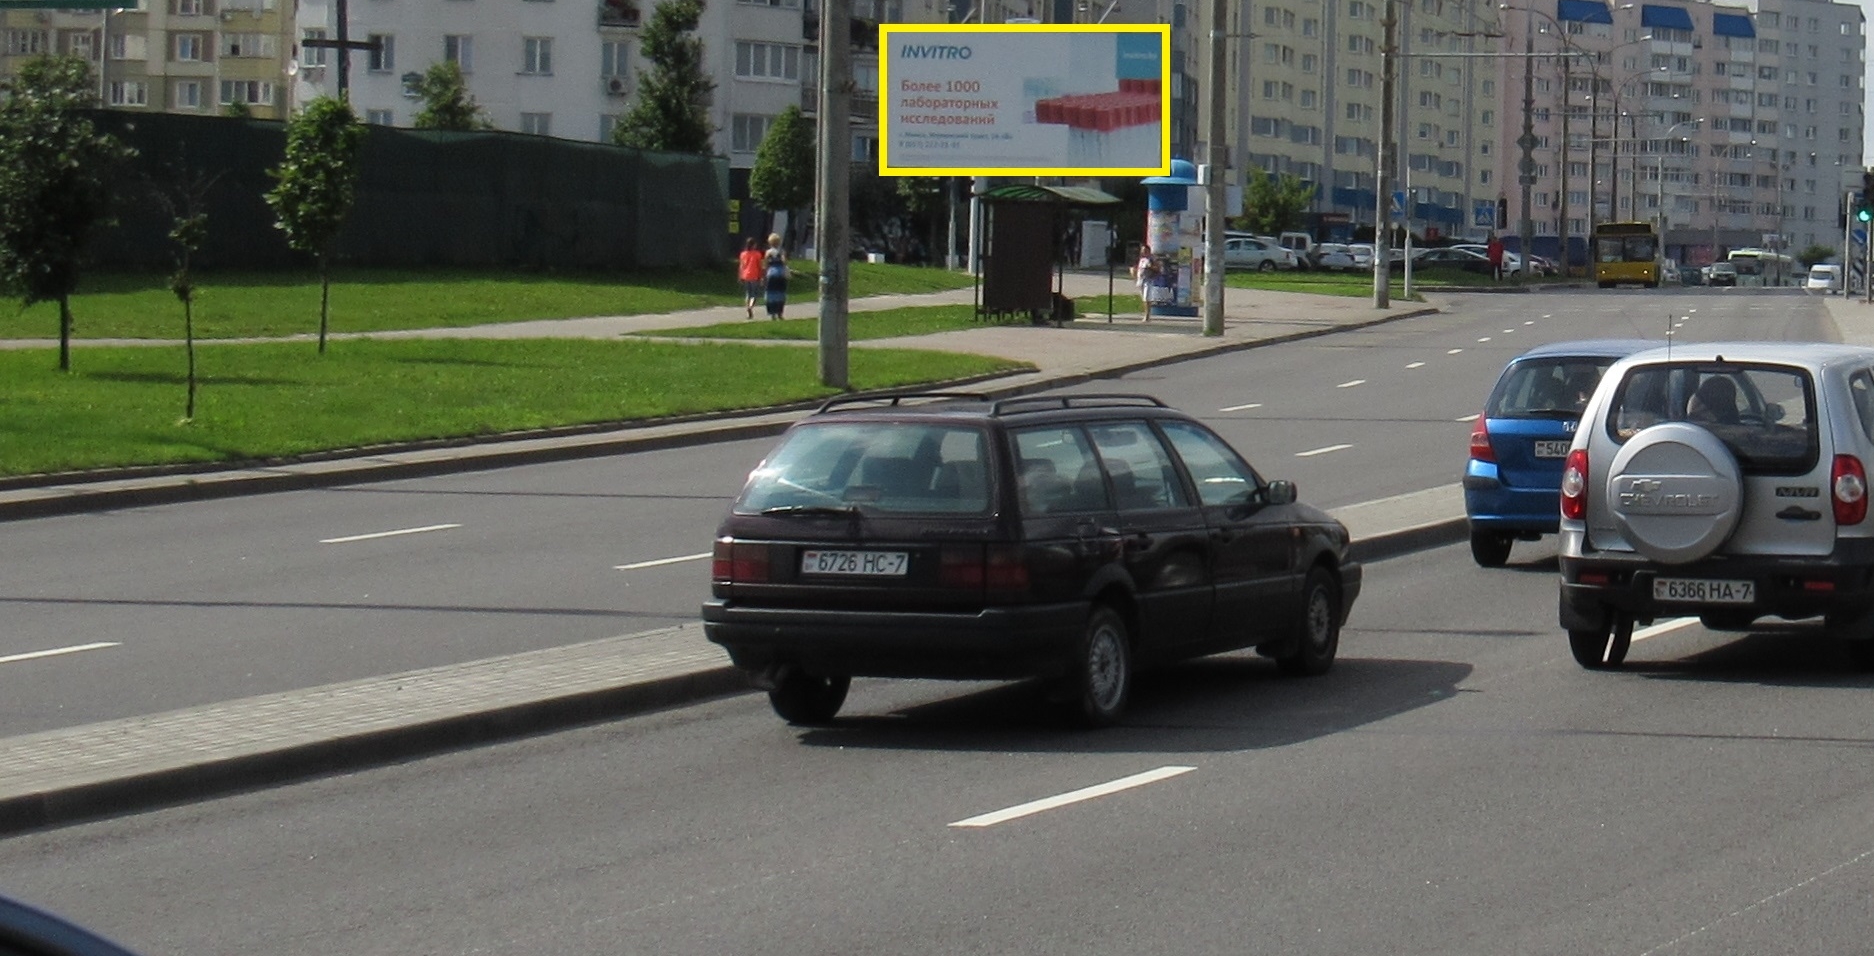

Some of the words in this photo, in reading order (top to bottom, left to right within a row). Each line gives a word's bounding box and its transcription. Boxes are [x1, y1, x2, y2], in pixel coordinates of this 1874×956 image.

[900, 44, 972, 60] INVITRO
[901, 79, 941, 93] Более
[946, 80, 980, 93] 1000
[900, 96, 998, 112] лабораторных
[900, 114, 995, 126] исследований
[1620, 493, 1720, 507] CHEVROLET
[818, 552, 857, 572] 6726
[862, 553, 906, 575] HC-7
[1668, 581, 1706, 599] 6366
[1709, 583, 1751, 601] HA-7
